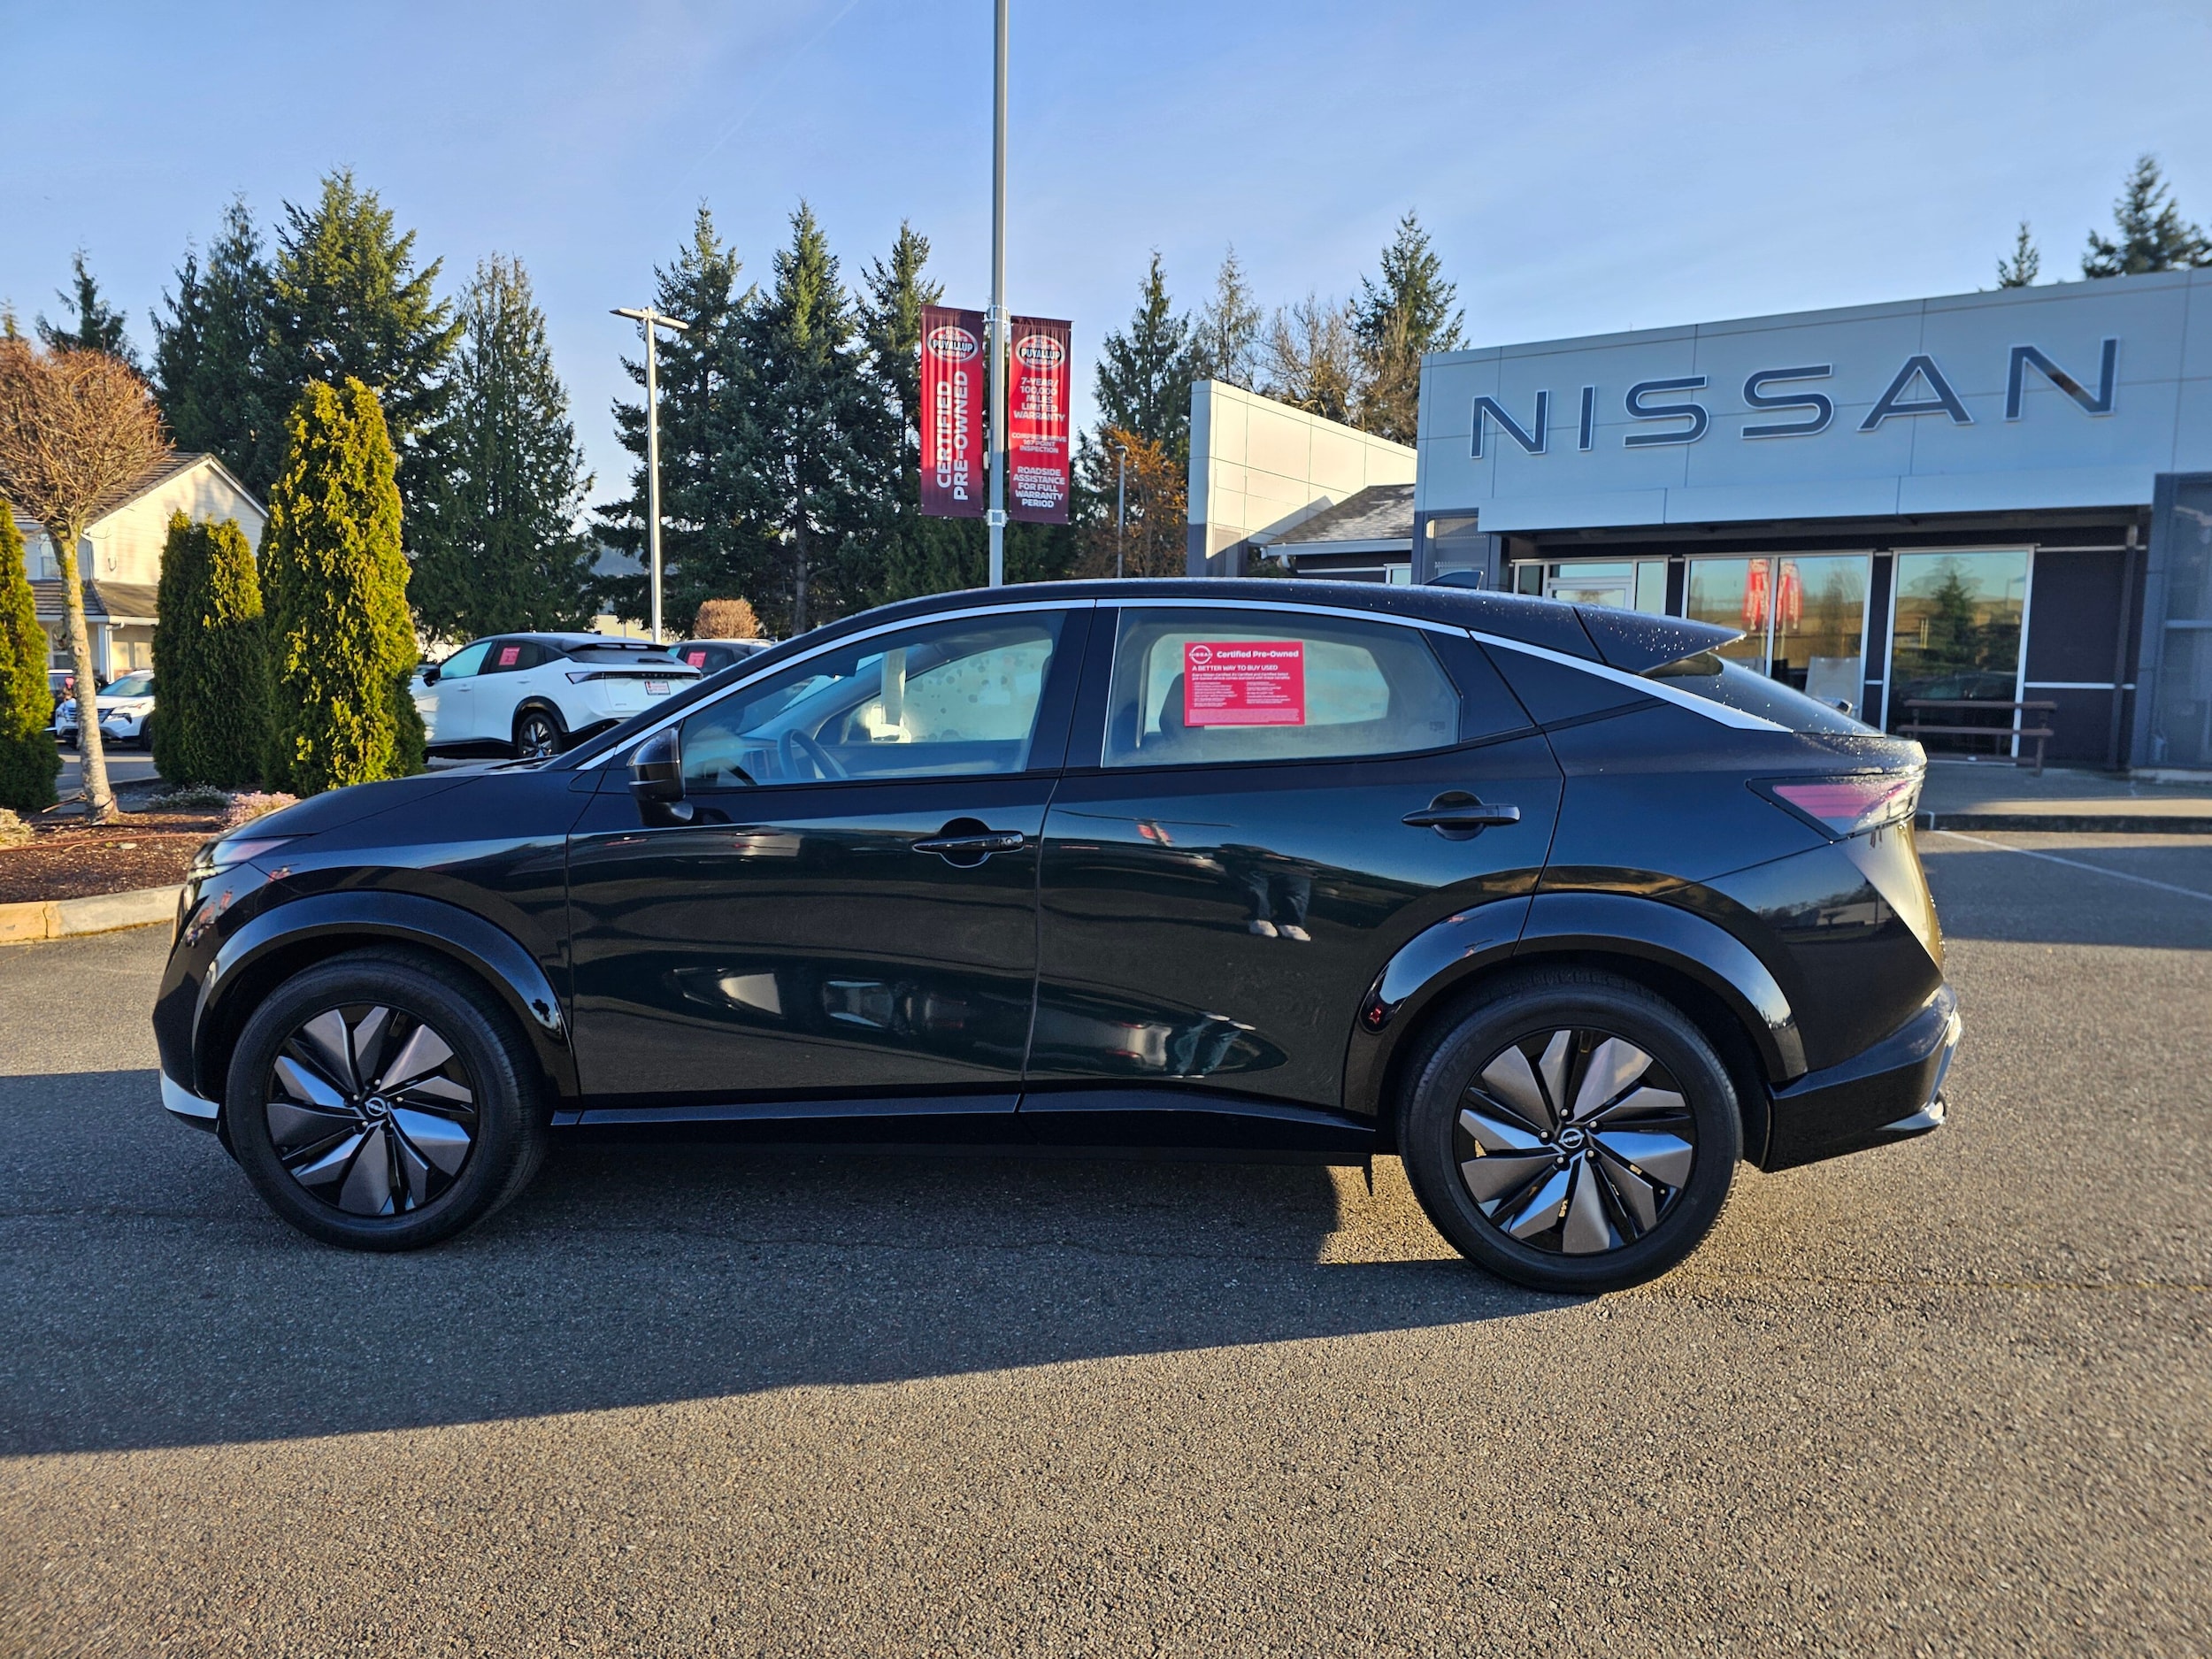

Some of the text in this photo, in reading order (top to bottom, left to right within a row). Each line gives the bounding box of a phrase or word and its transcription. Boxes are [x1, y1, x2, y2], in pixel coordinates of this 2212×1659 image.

[933, 339, 973, 352] PUYALLUP
[1021, 348, 1060, 360] PUYALLUP
[1021, 376, 1059, 387] 7-YEAR/
[1020, 386, 1058, 396] 100,000
[1026, 395, 1053, 403] MILES
[1471, 336, 2121, 460] NISSAN
[1021, 403, 1058, 412] LIMITED
[1014, 411, 1065, 422] WARRANTY
[937, 380, 952, 488] CERTIFIED
[954, 371, 968, 500] PRE-OWNED
[1018, 466, 1061, 477] ROADSIDE
[1013, 474, 1065, 485] ASSISTANCE
[1018, 482, 1058, 493] FOR FULL
[1015, 490, 1064, 501] WARRANTY
[1022, 498, 1054, 508] PERIOD
